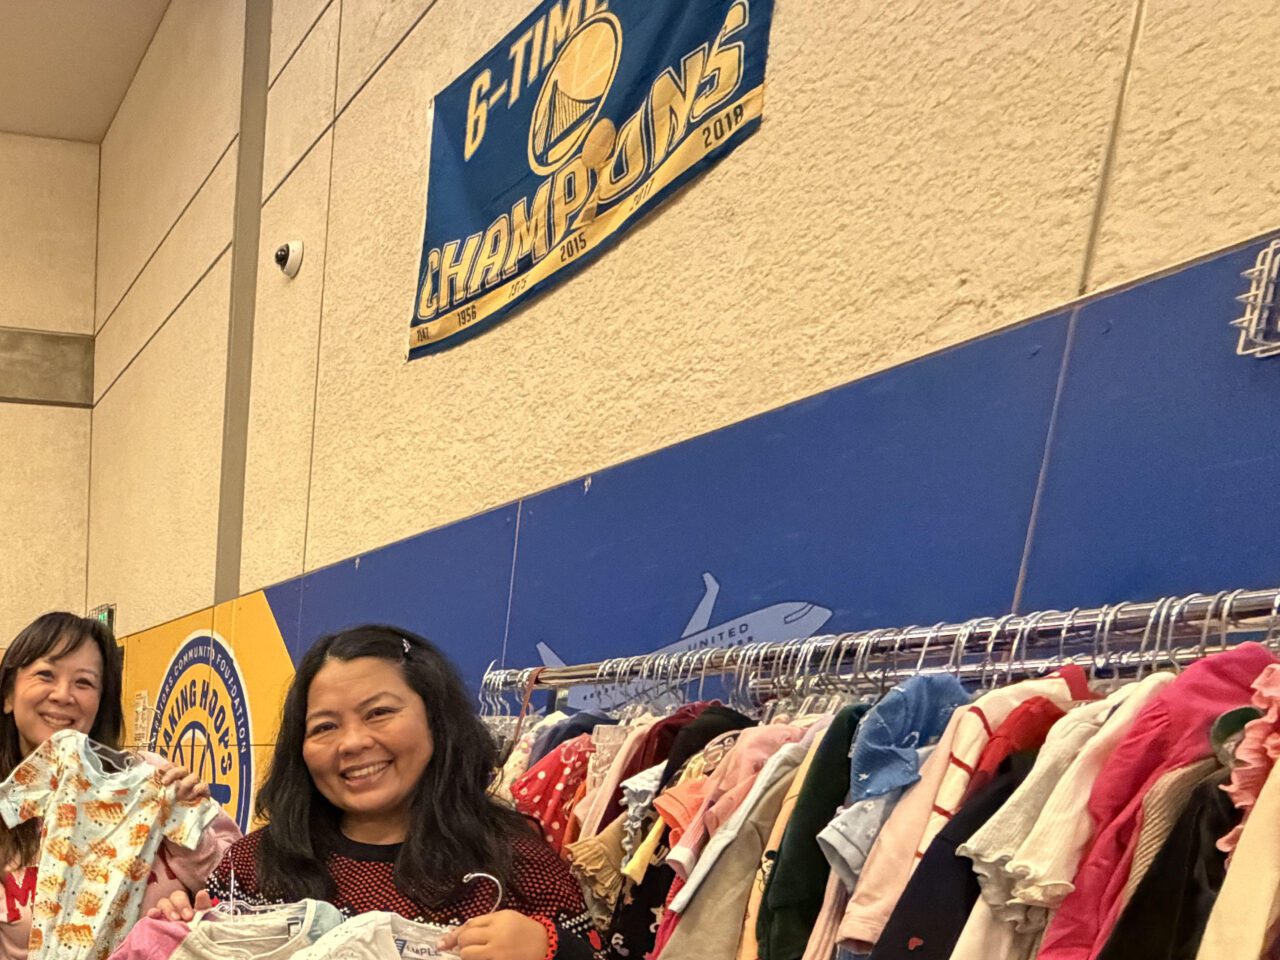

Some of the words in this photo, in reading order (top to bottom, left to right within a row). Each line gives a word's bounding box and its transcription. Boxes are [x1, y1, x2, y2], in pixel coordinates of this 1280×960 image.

[464, 0, 608, 163] 6-TIM
[457, 305, 477, 327] 1956
[560, 232, 587, 262] 2015
[702, 104, 744, 149] 2018
[688, 623, 749, 652] UNITED
[200, 679, 232, 775] HOOPS
